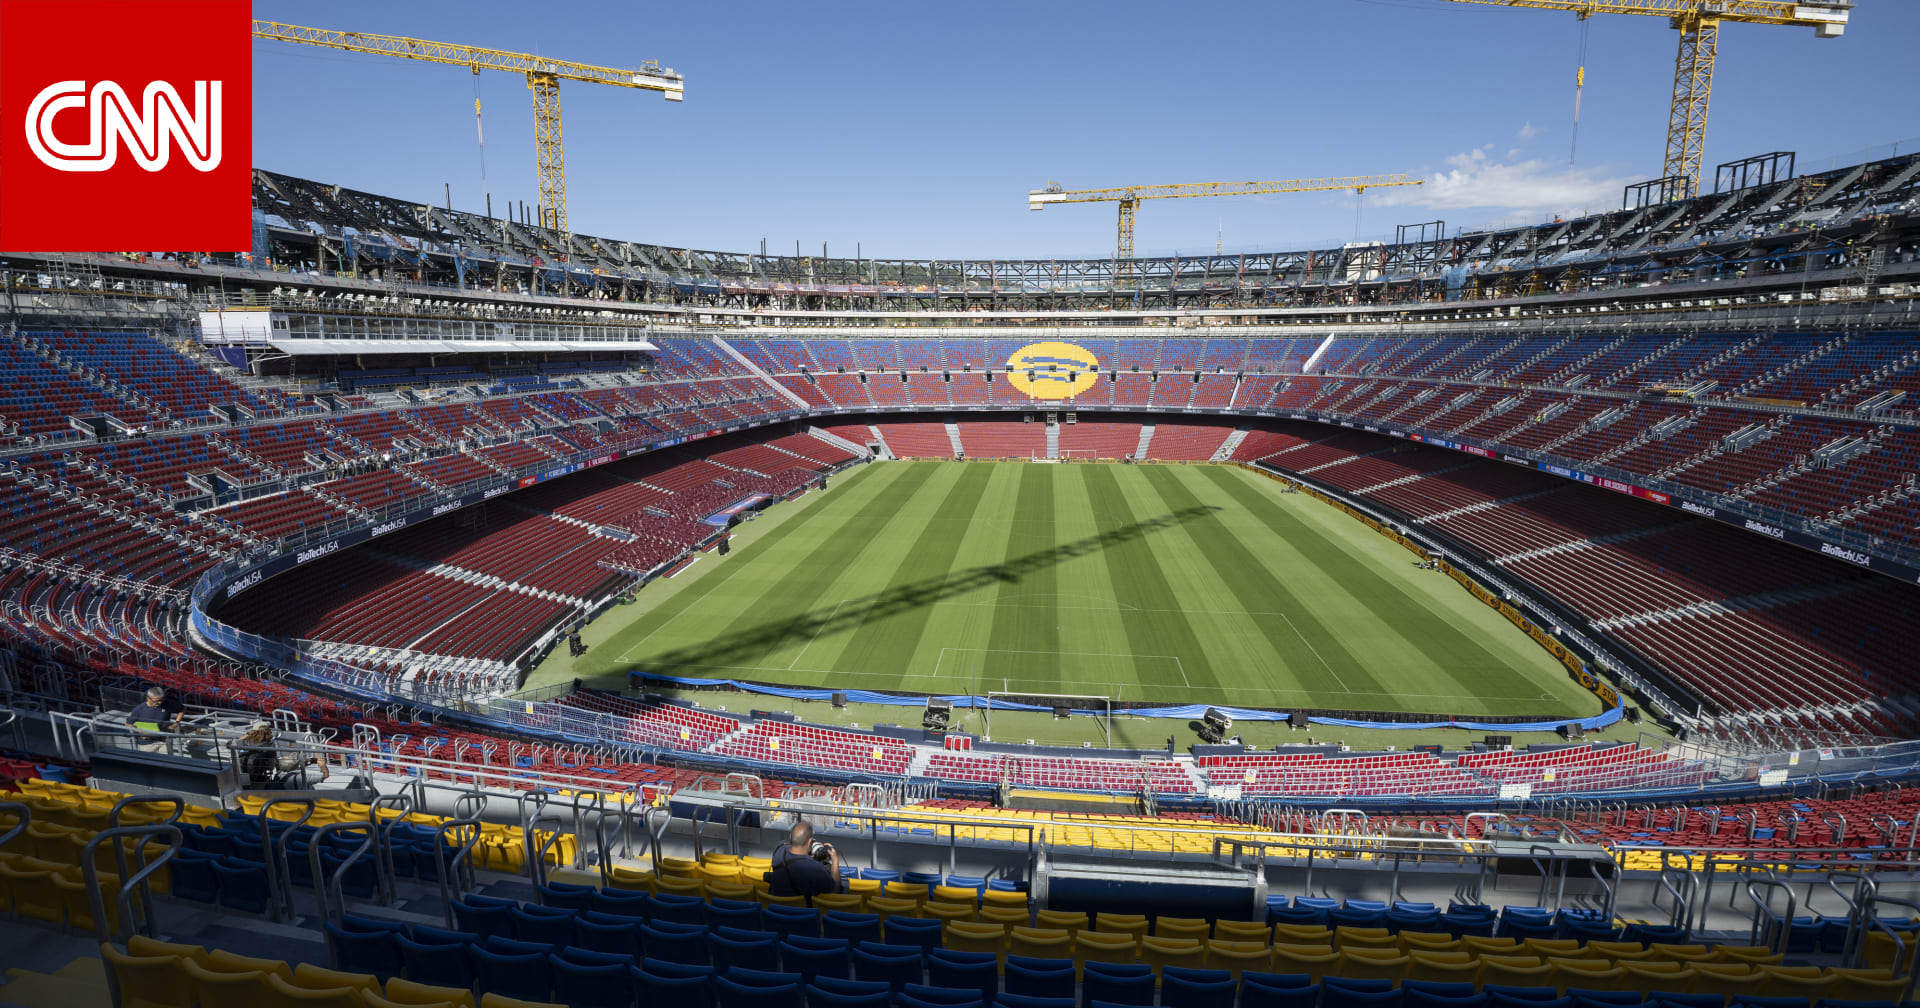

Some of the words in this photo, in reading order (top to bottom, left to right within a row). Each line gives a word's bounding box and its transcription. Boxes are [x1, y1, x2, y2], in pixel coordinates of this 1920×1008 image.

[432, 499, 462, 516] BioTechUSA
[1682, 501, 1715, 518] BioTechUSA
[371, 517, 406, 537] BioTechUSA
[1745, 519, 1784, 540] BioTechUSA
[297, 540, 339, 564] BioTechUSA
[1821, 542, 1870, 567] BioTechUSA
[226, 570, 263, 598] BioTechUSA
[1502, 605, 1521, 624] STANLEY
[1533, 629, 1554, 648] STANLEY
